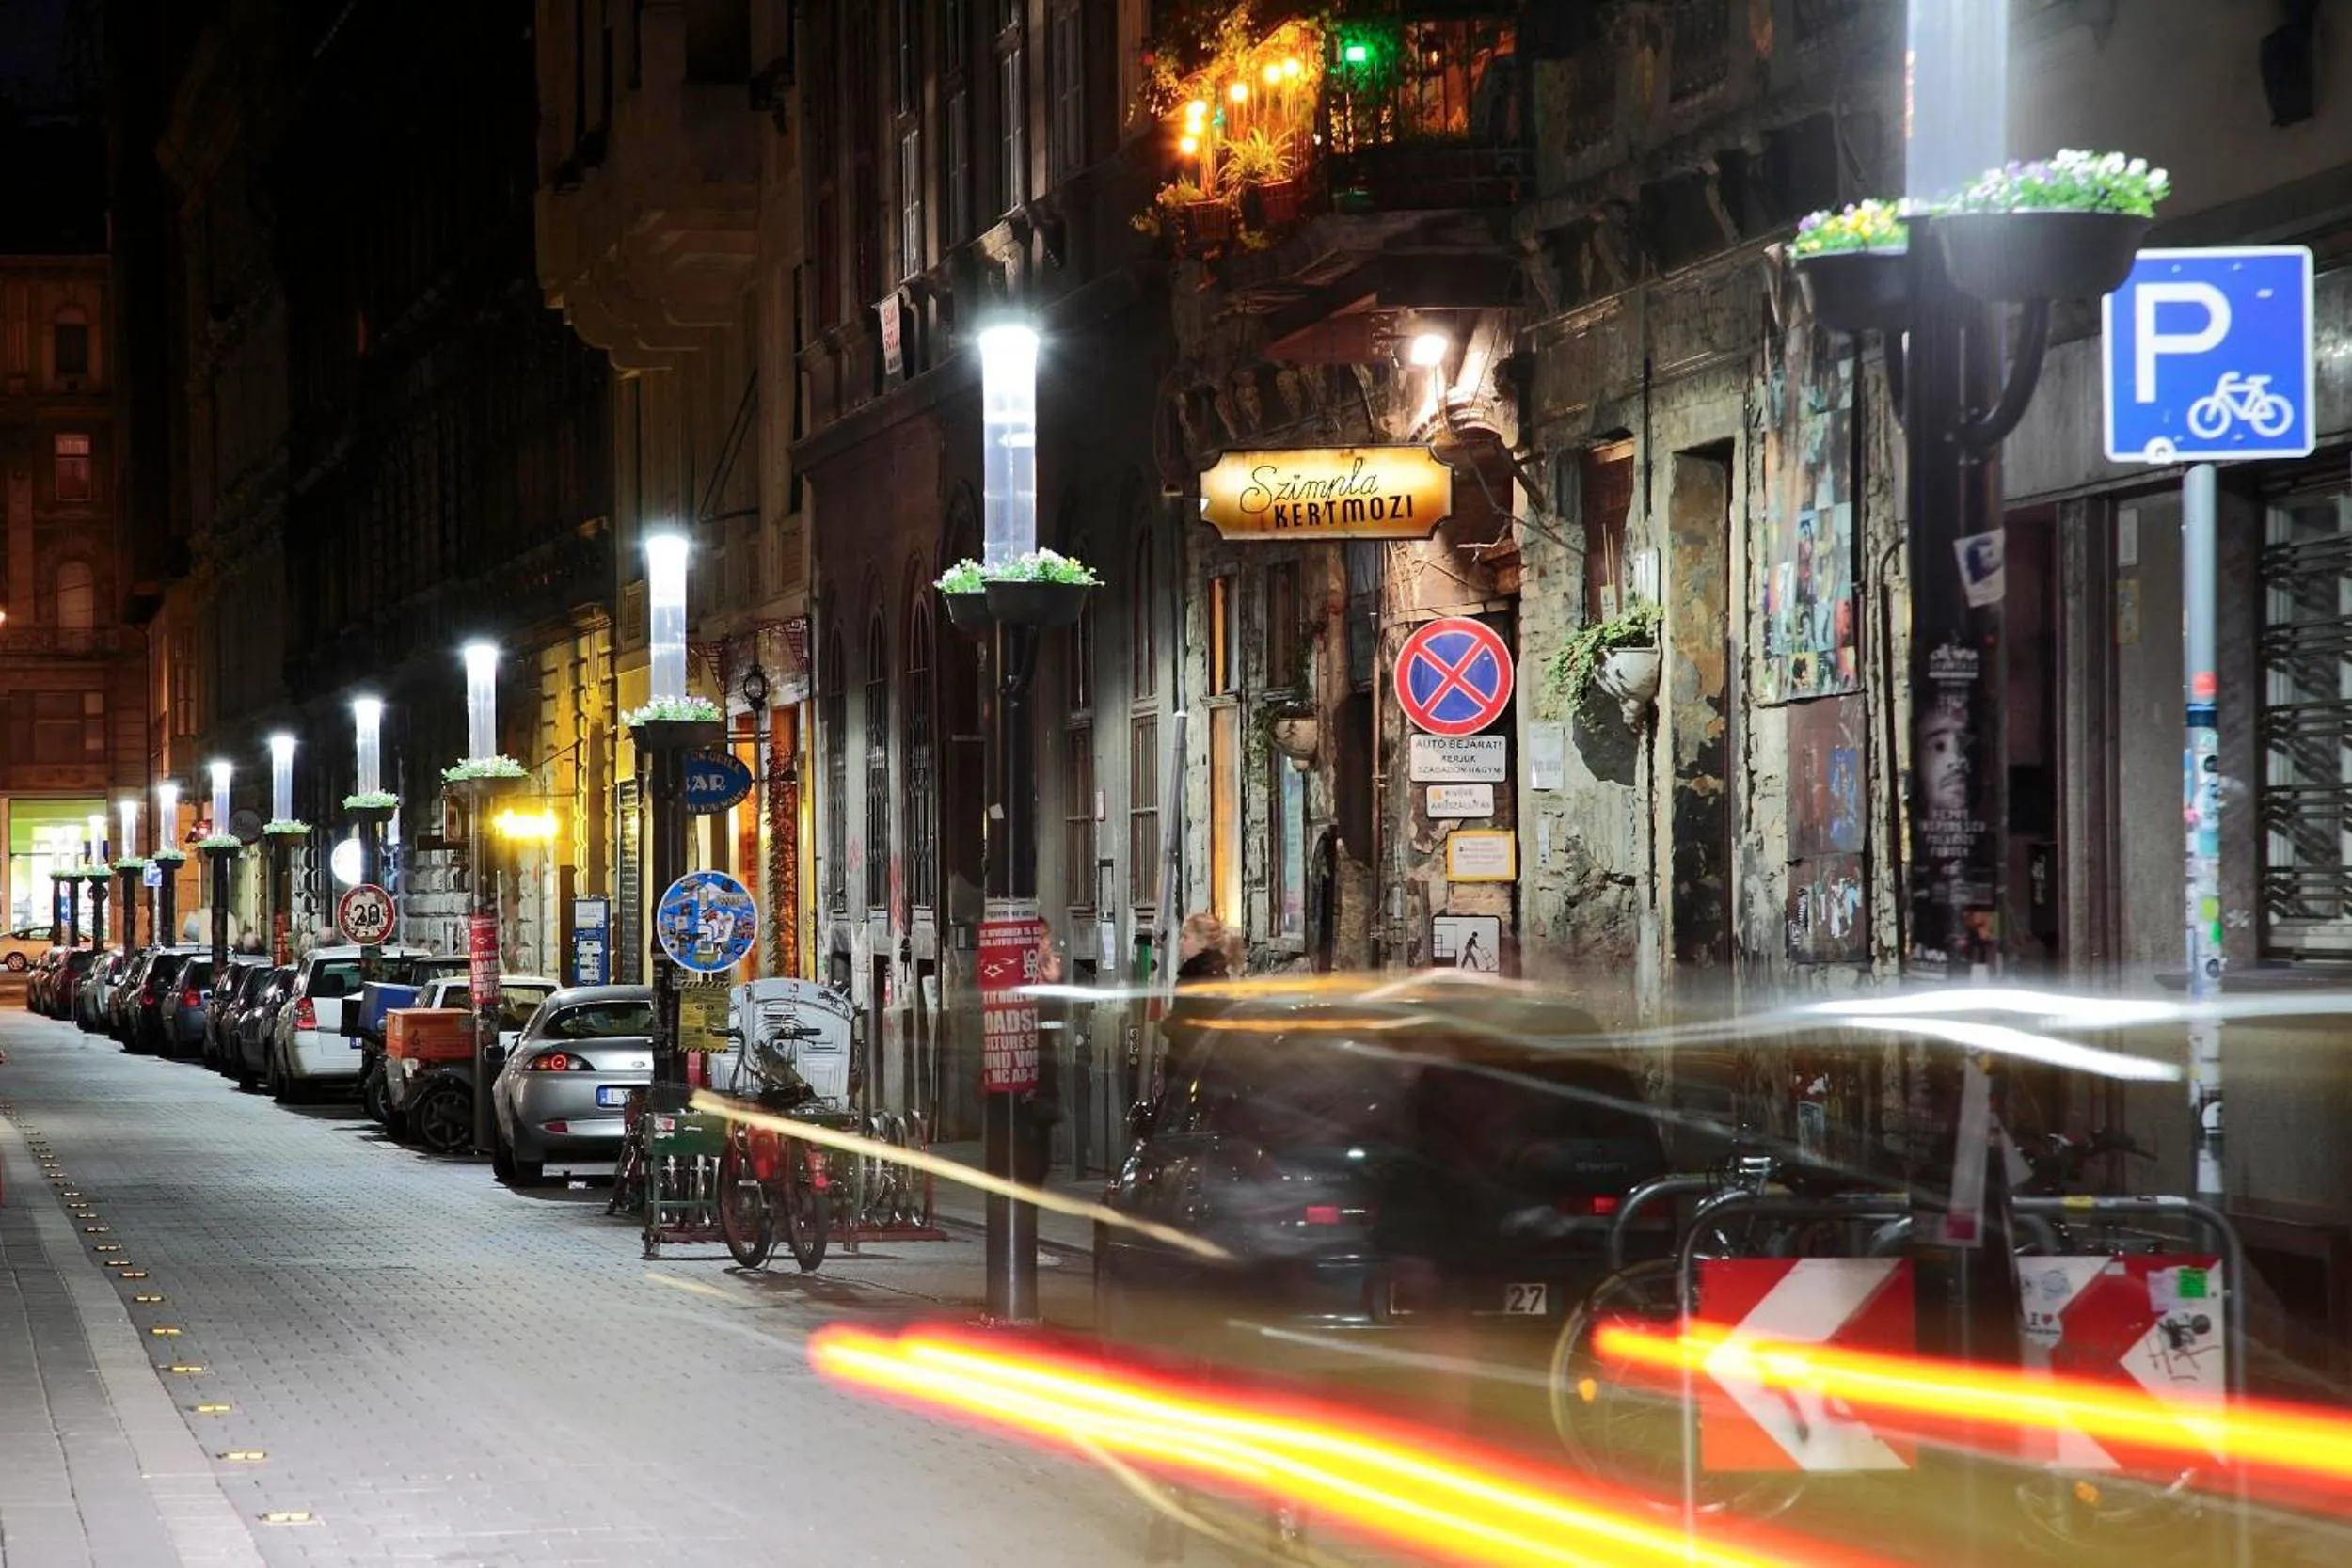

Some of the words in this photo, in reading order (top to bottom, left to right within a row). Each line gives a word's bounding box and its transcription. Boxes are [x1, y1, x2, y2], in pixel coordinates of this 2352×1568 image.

[2133, 282, 2233, 405] P
[1239, 457, 1380, 514] Szimpla
[1273, 494, 1415, 529] KERTMOZI
[353, 903, 381, 927] 20
[1508, 1285, 1545, 1313] 27
